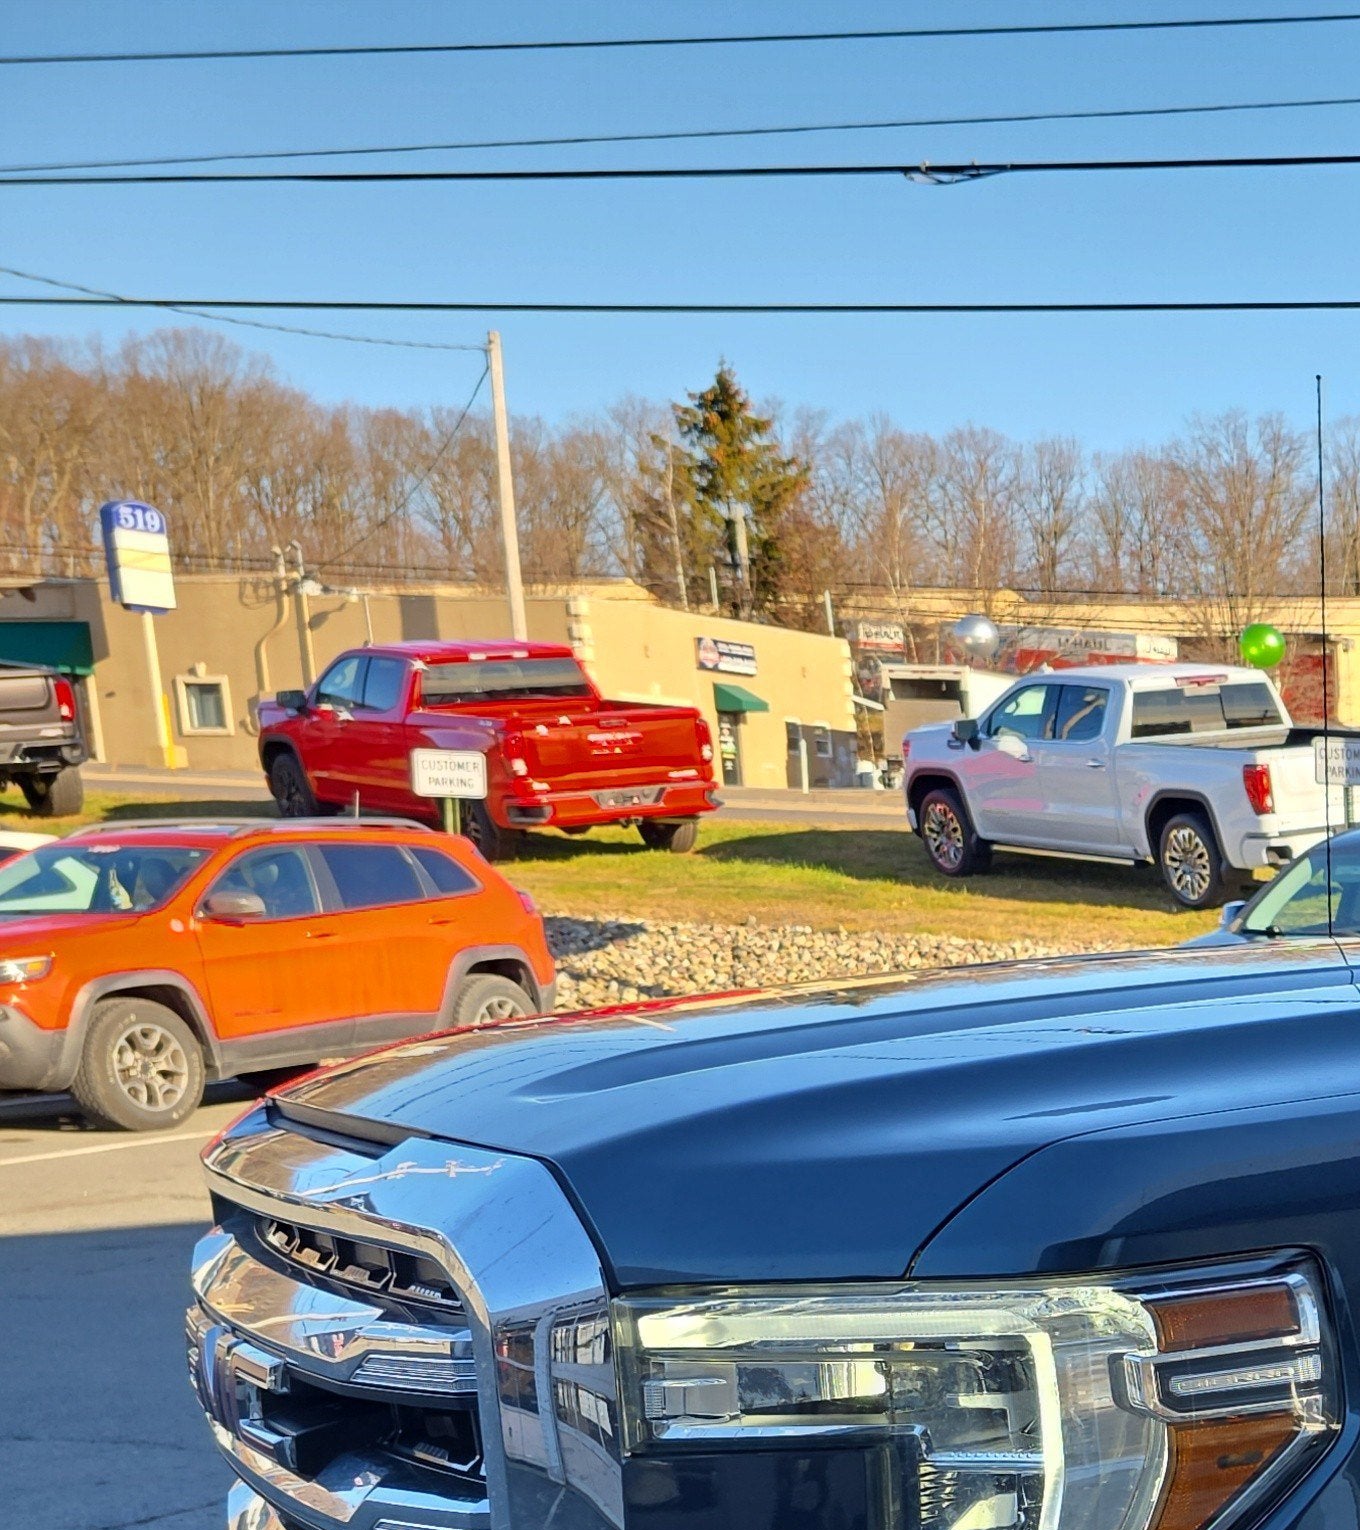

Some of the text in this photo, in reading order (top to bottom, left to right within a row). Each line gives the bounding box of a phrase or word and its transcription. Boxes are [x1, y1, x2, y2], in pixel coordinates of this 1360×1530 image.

[119, 505, 161, 533] 519
[421, 760, 480, 773] CUSTOMER
[428, 776, 474, 789] PARKING
